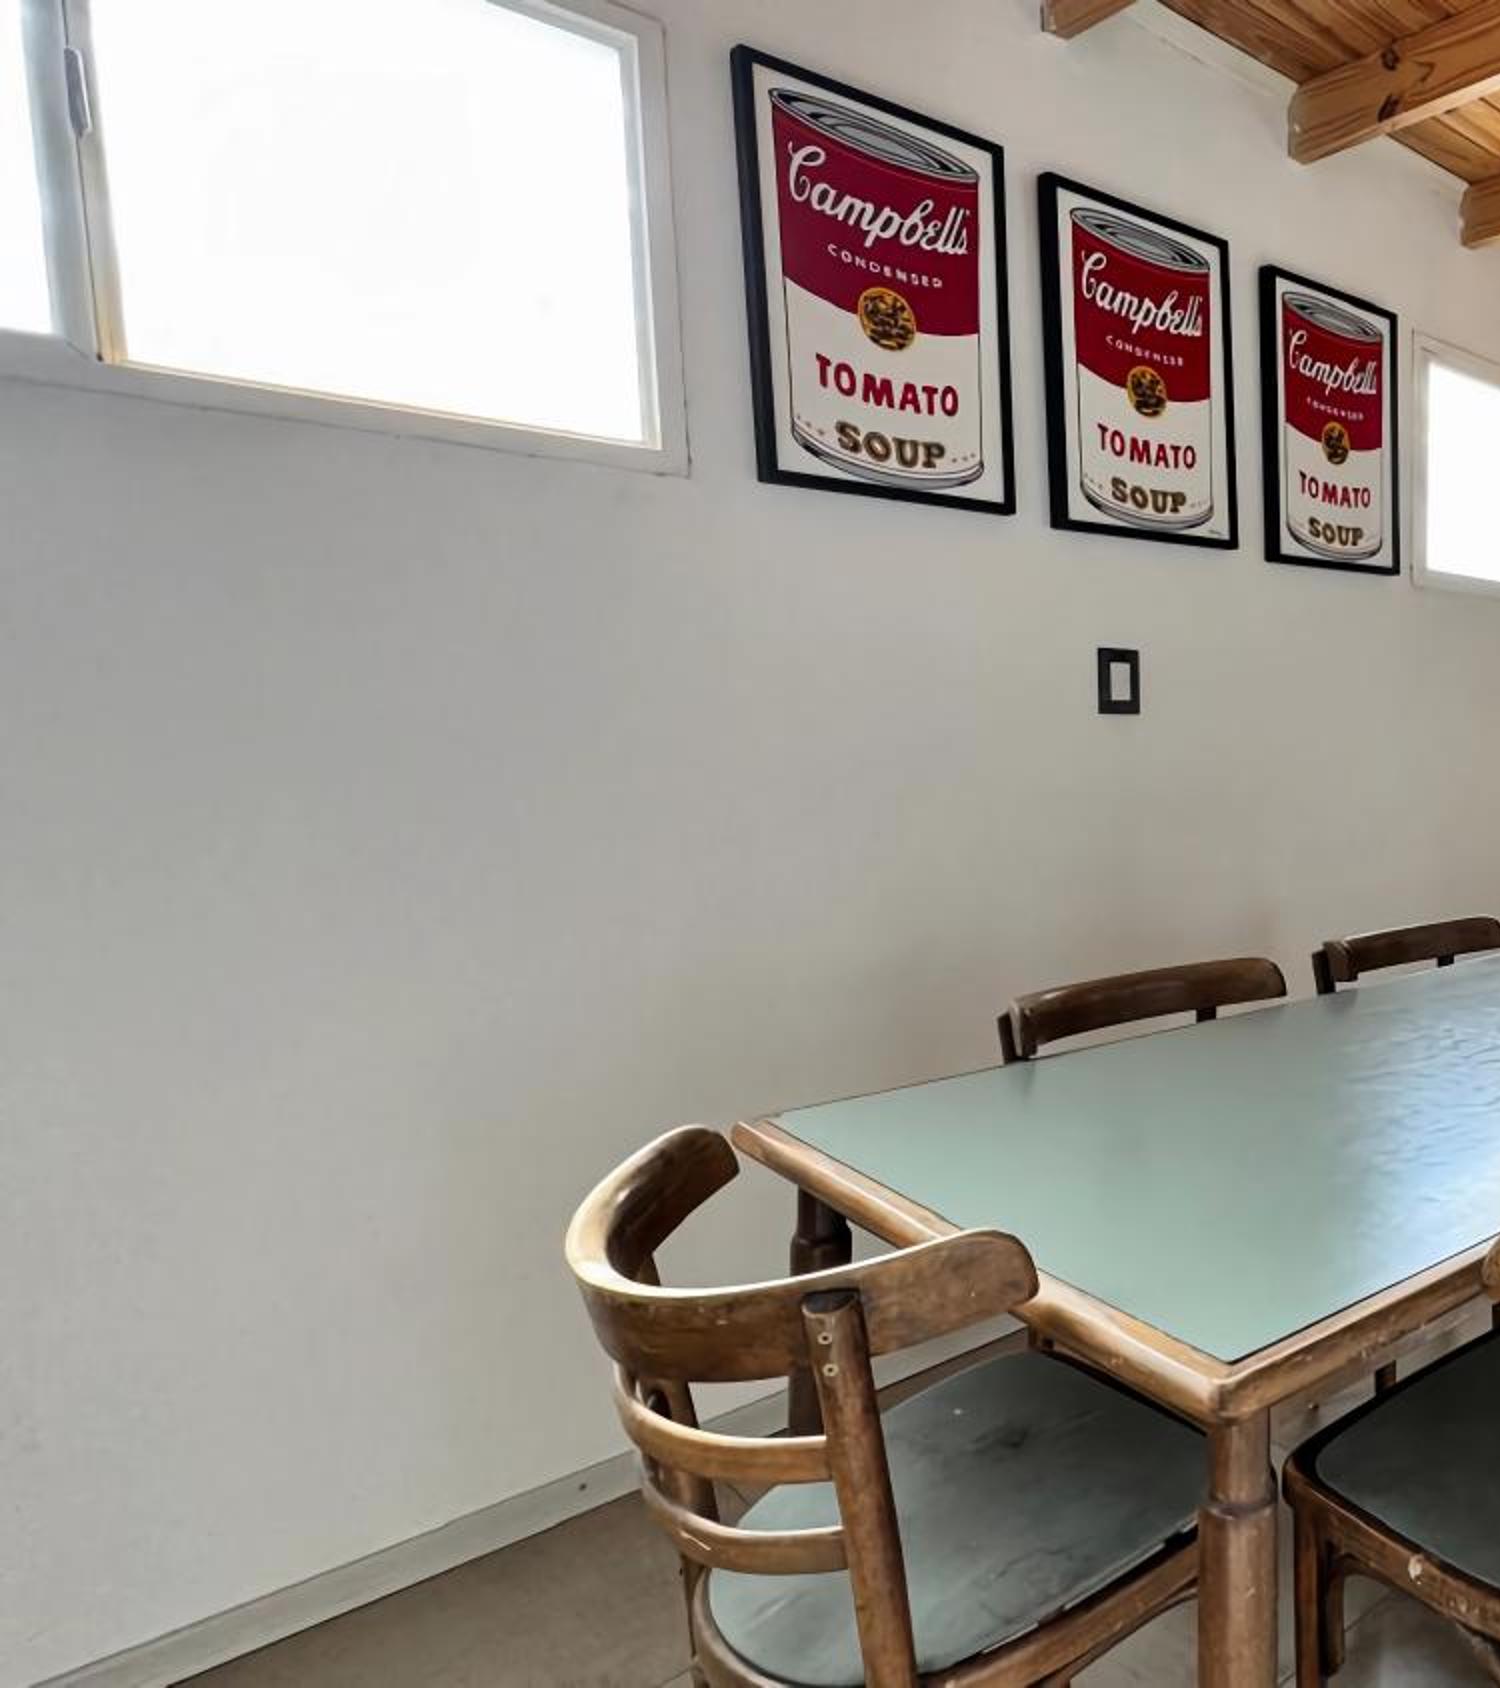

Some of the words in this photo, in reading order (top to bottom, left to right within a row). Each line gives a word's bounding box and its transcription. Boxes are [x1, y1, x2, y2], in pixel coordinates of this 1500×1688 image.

[788, 140, 969, 255] Campbell's
[827, 243, 943, 288] CONDENSED
[1289, 328, 1377, 395] Campbells
[816, 353, 959, 417] TOMATO
[835, 421, 946, 468] SOUP
[1097, 423, 1196, 469] TOMATO
[1111, 477, 1186, 514] SOUP
[1299, 470, 1371, 508] TOMATO
[1308, 517, 1363, 546] SOUP
